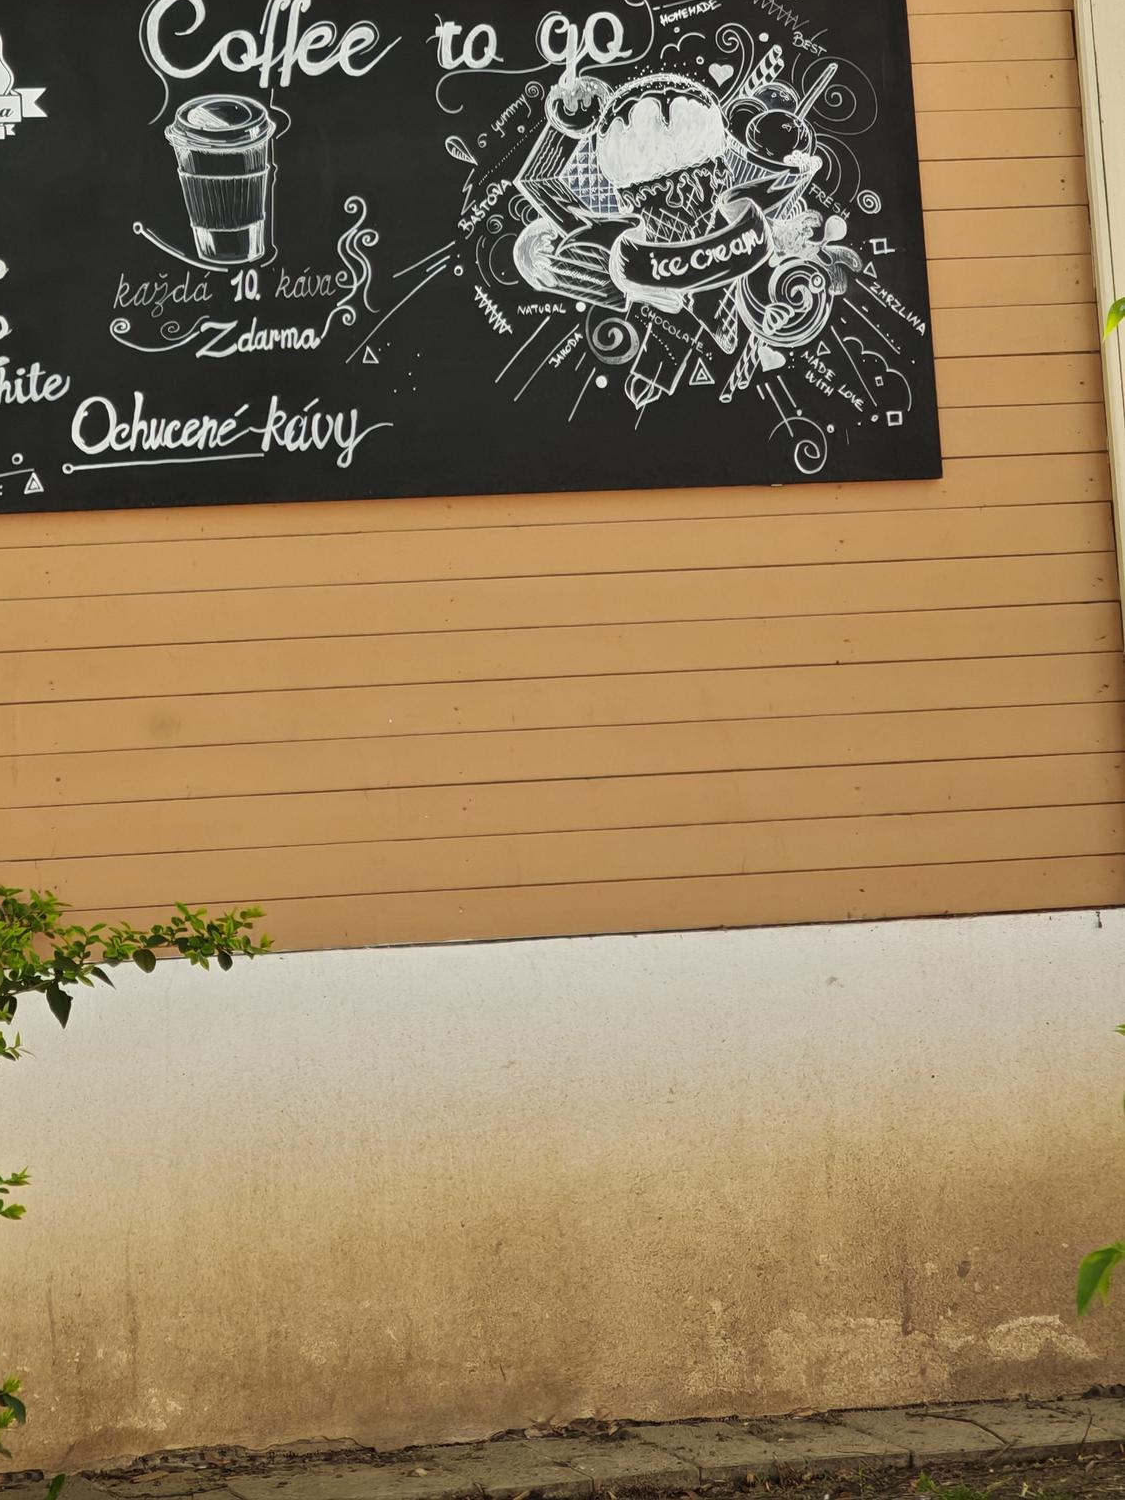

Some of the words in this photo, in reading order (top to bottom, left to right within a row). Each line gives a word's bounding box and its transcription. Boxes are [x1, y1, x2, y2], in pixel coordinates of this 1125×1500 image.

[435, 14, 503, 69] to
[540, 12, 633, 88] go
[792, 31, 828, 57] BEST
[491, 94, 532, 138] yummy
[458, 179, 512, 239] BAŠTOVA
[808, 183, 850, 220] FRESH
[649, 252, 689, 280] ice
[690, 228, 764, 270] cream
[114, 271, 213, 316] každá
[231, 268, 261, 301] 10.
[275, 267, 338, 300] káva
[517, 303, 567, 316] NATURAL
[870, 281, 926, 336] ZMRZLINA
[195, 319, 327, 359] Zdarma
[548, 332, 584, 368] JAHODA
[640, 305, 704, 353] CHOCOLATE
[801, 351, 835, 382] MADE
[805, 370, 834, 396] WITH
[838, 384, 864, 412] LOVE
[71, 391, 251, 454] Ochucené
[261, 395, 363, 468] kávy
